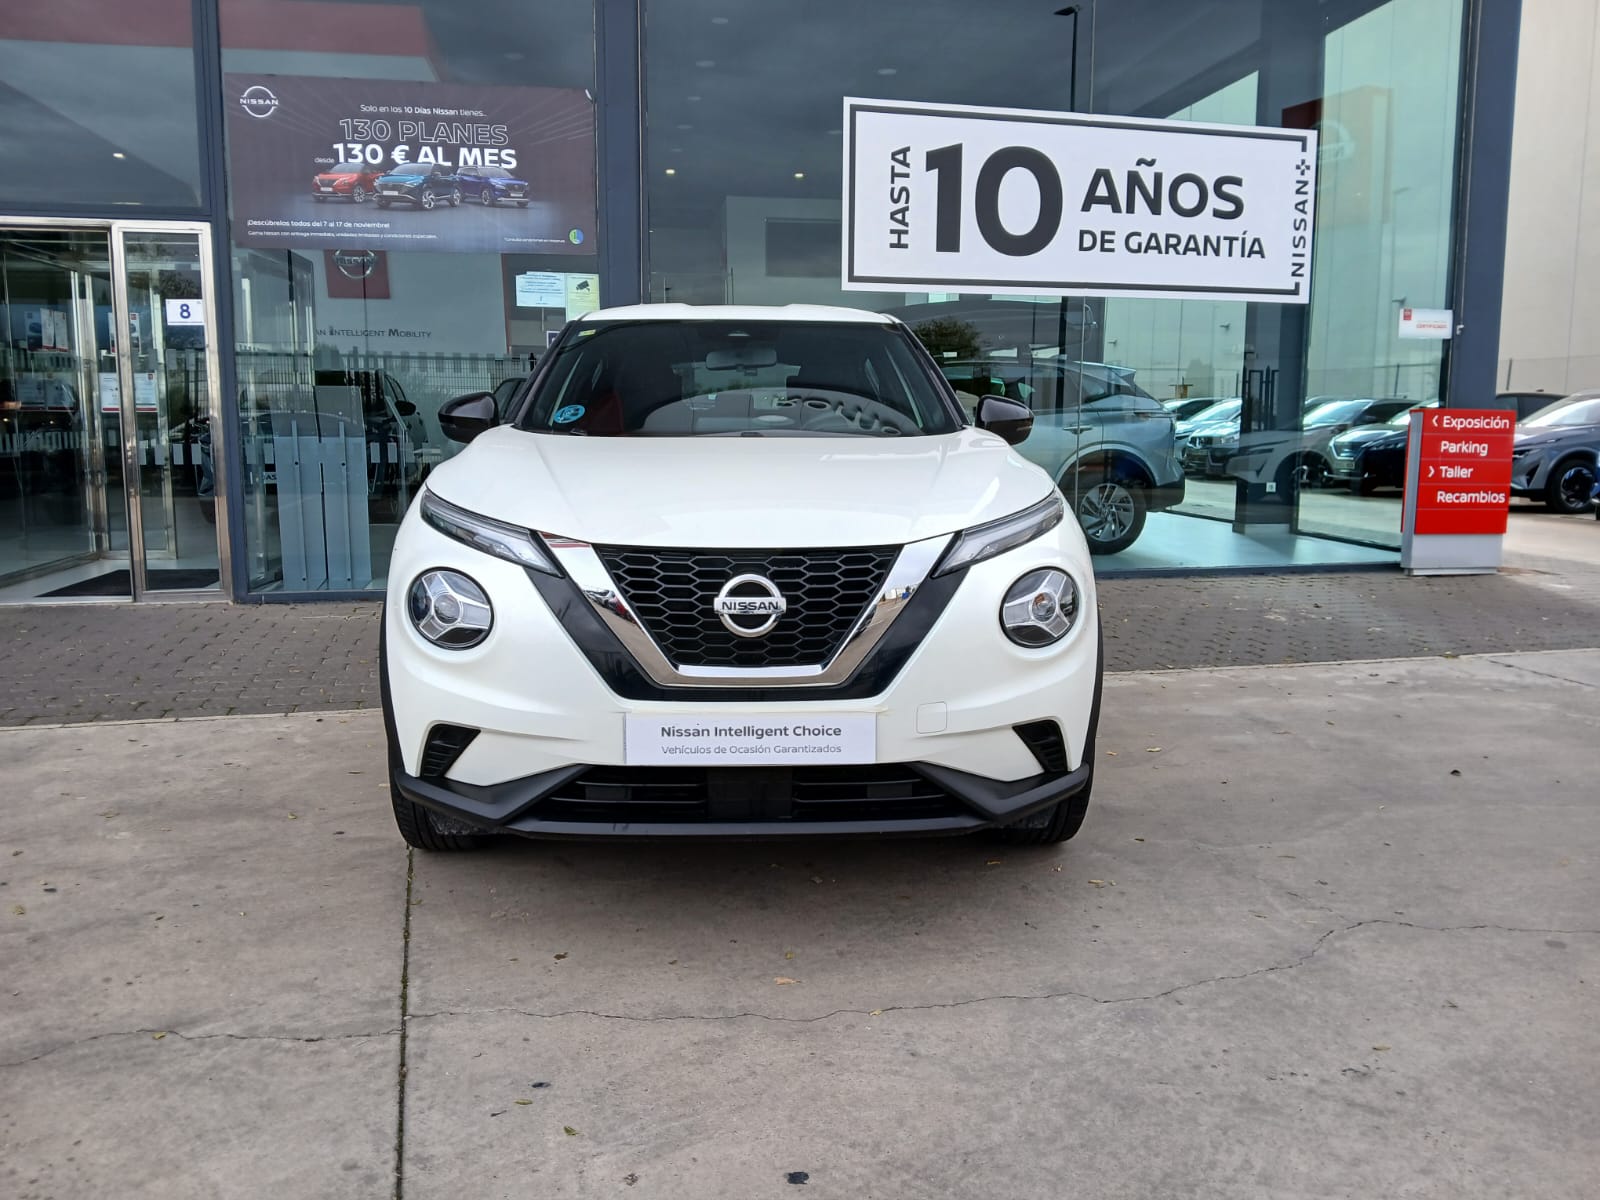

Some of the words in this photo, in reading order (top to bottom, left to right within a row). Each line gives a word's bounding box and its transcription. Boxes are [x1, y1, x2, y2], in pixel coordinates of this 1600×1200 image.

[360, 104, 377, 112] Solo
[390, 105, 402, 113] los
[433, 107, 458, 115] Nissan
[340, 118, 391, 142] 130
[398, 120, 509, 145] PLANES
[333, 143, 383, 164] 130
[390, 145, 410, 164] €
[417, 146, 452, 167] AL
[458, 147, 517, 169] MES
[889, 145, 911, 249] HASTA
[926, 142, 1063, 257] 10
[1080, 157, 1245, 220] AÑOS
[312, 220, 322, 228] del
[1078, 229, 1116, 253] DE
[1124, 230, 1266, 259] GARANTÍA
[180, 303, 191, 319] 8
[1443, 415, 1510, 431] Exposición
[1440, 440, 1489, 457] Parking
[1439, 465, 1474, 478] Taller
[1436, 490, 1506, 504] Recambios
[721, 601, 779, 611] NISSAN
[660, 726, 710, 737] Nissan
[714, 726, 790, 740] Intelligent
[792, 725, 842, 737] Choice
[661, 745, 712, 754] Vehículos
[714, 744, 727, 754] de
[729, 744, 771, 754] Ocasión
[773, 743, 842, 754] Garantizados
